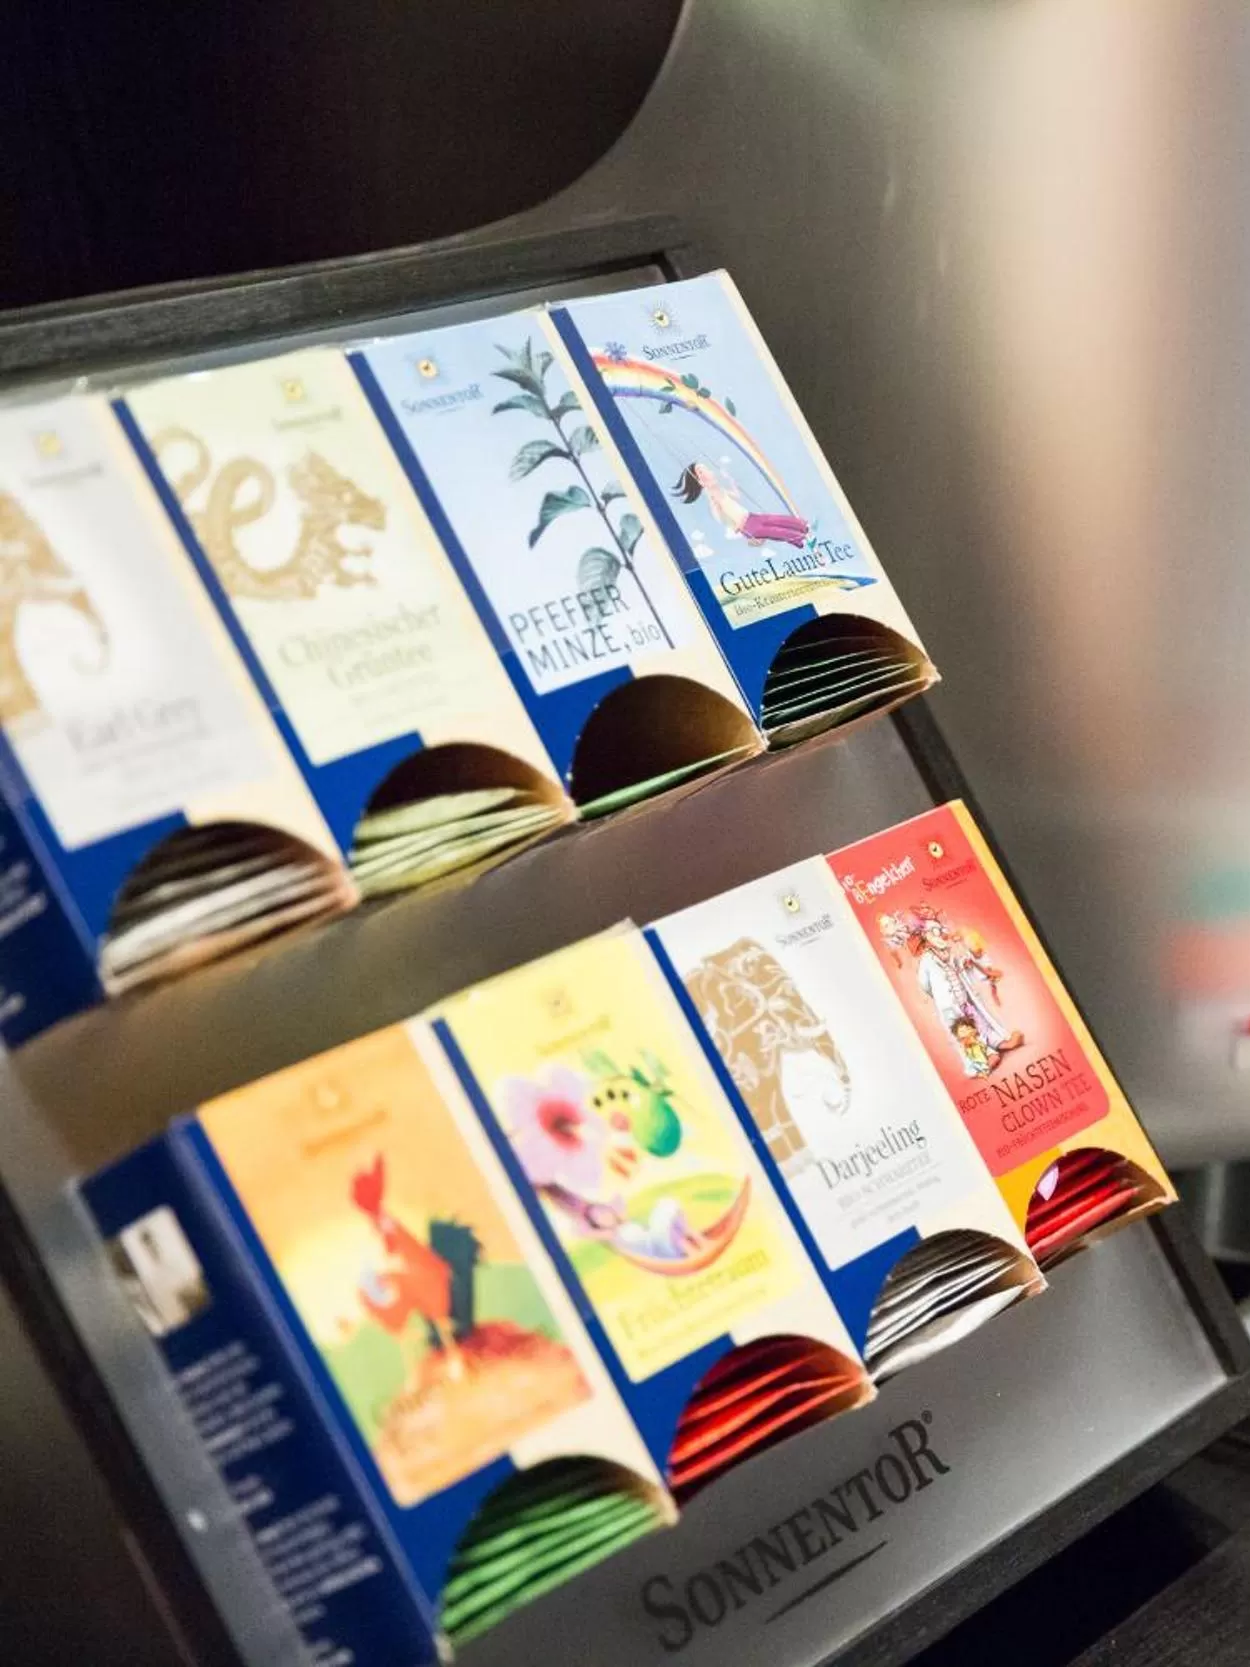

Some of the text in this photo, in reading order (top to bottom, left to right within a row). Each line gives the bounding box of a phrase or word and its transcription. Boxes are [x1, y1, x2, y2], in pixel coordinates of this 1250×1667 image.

[508, 584, 631, 645] PFEFFER
[626, 620, 662, 646] bio
[958, 1048, 1073, 1115] ROTE NASEN
[1001, 1072, 1094, 1134] CLOWN TEE
[816, 1119, 928, 1190] Darjeeling
